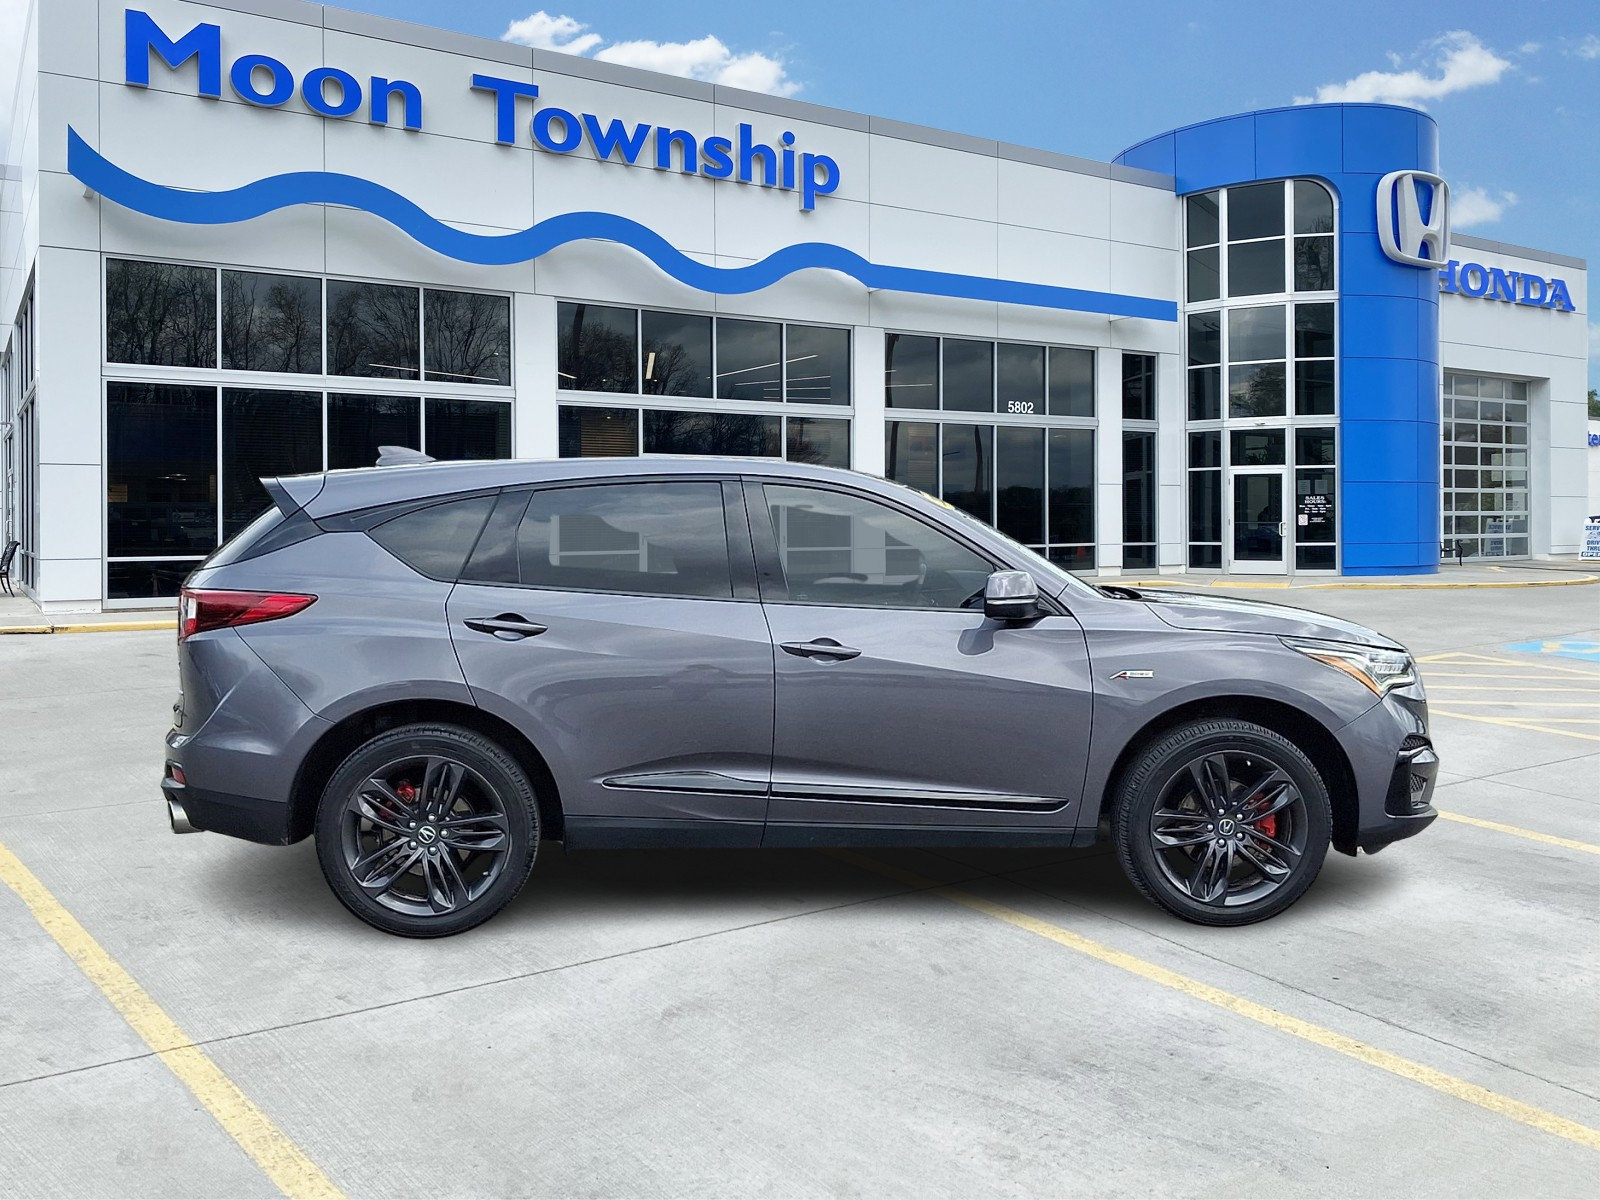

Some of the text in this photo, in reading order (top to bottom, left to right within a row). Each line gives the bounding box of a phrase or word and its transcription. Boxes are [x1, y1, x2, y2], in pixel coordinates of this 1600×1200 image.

[125, 9, 840, 212] Moon Township
[1438, 260, 1576, 312] HONDA
[1007, 400, 1034, 414] 5802
